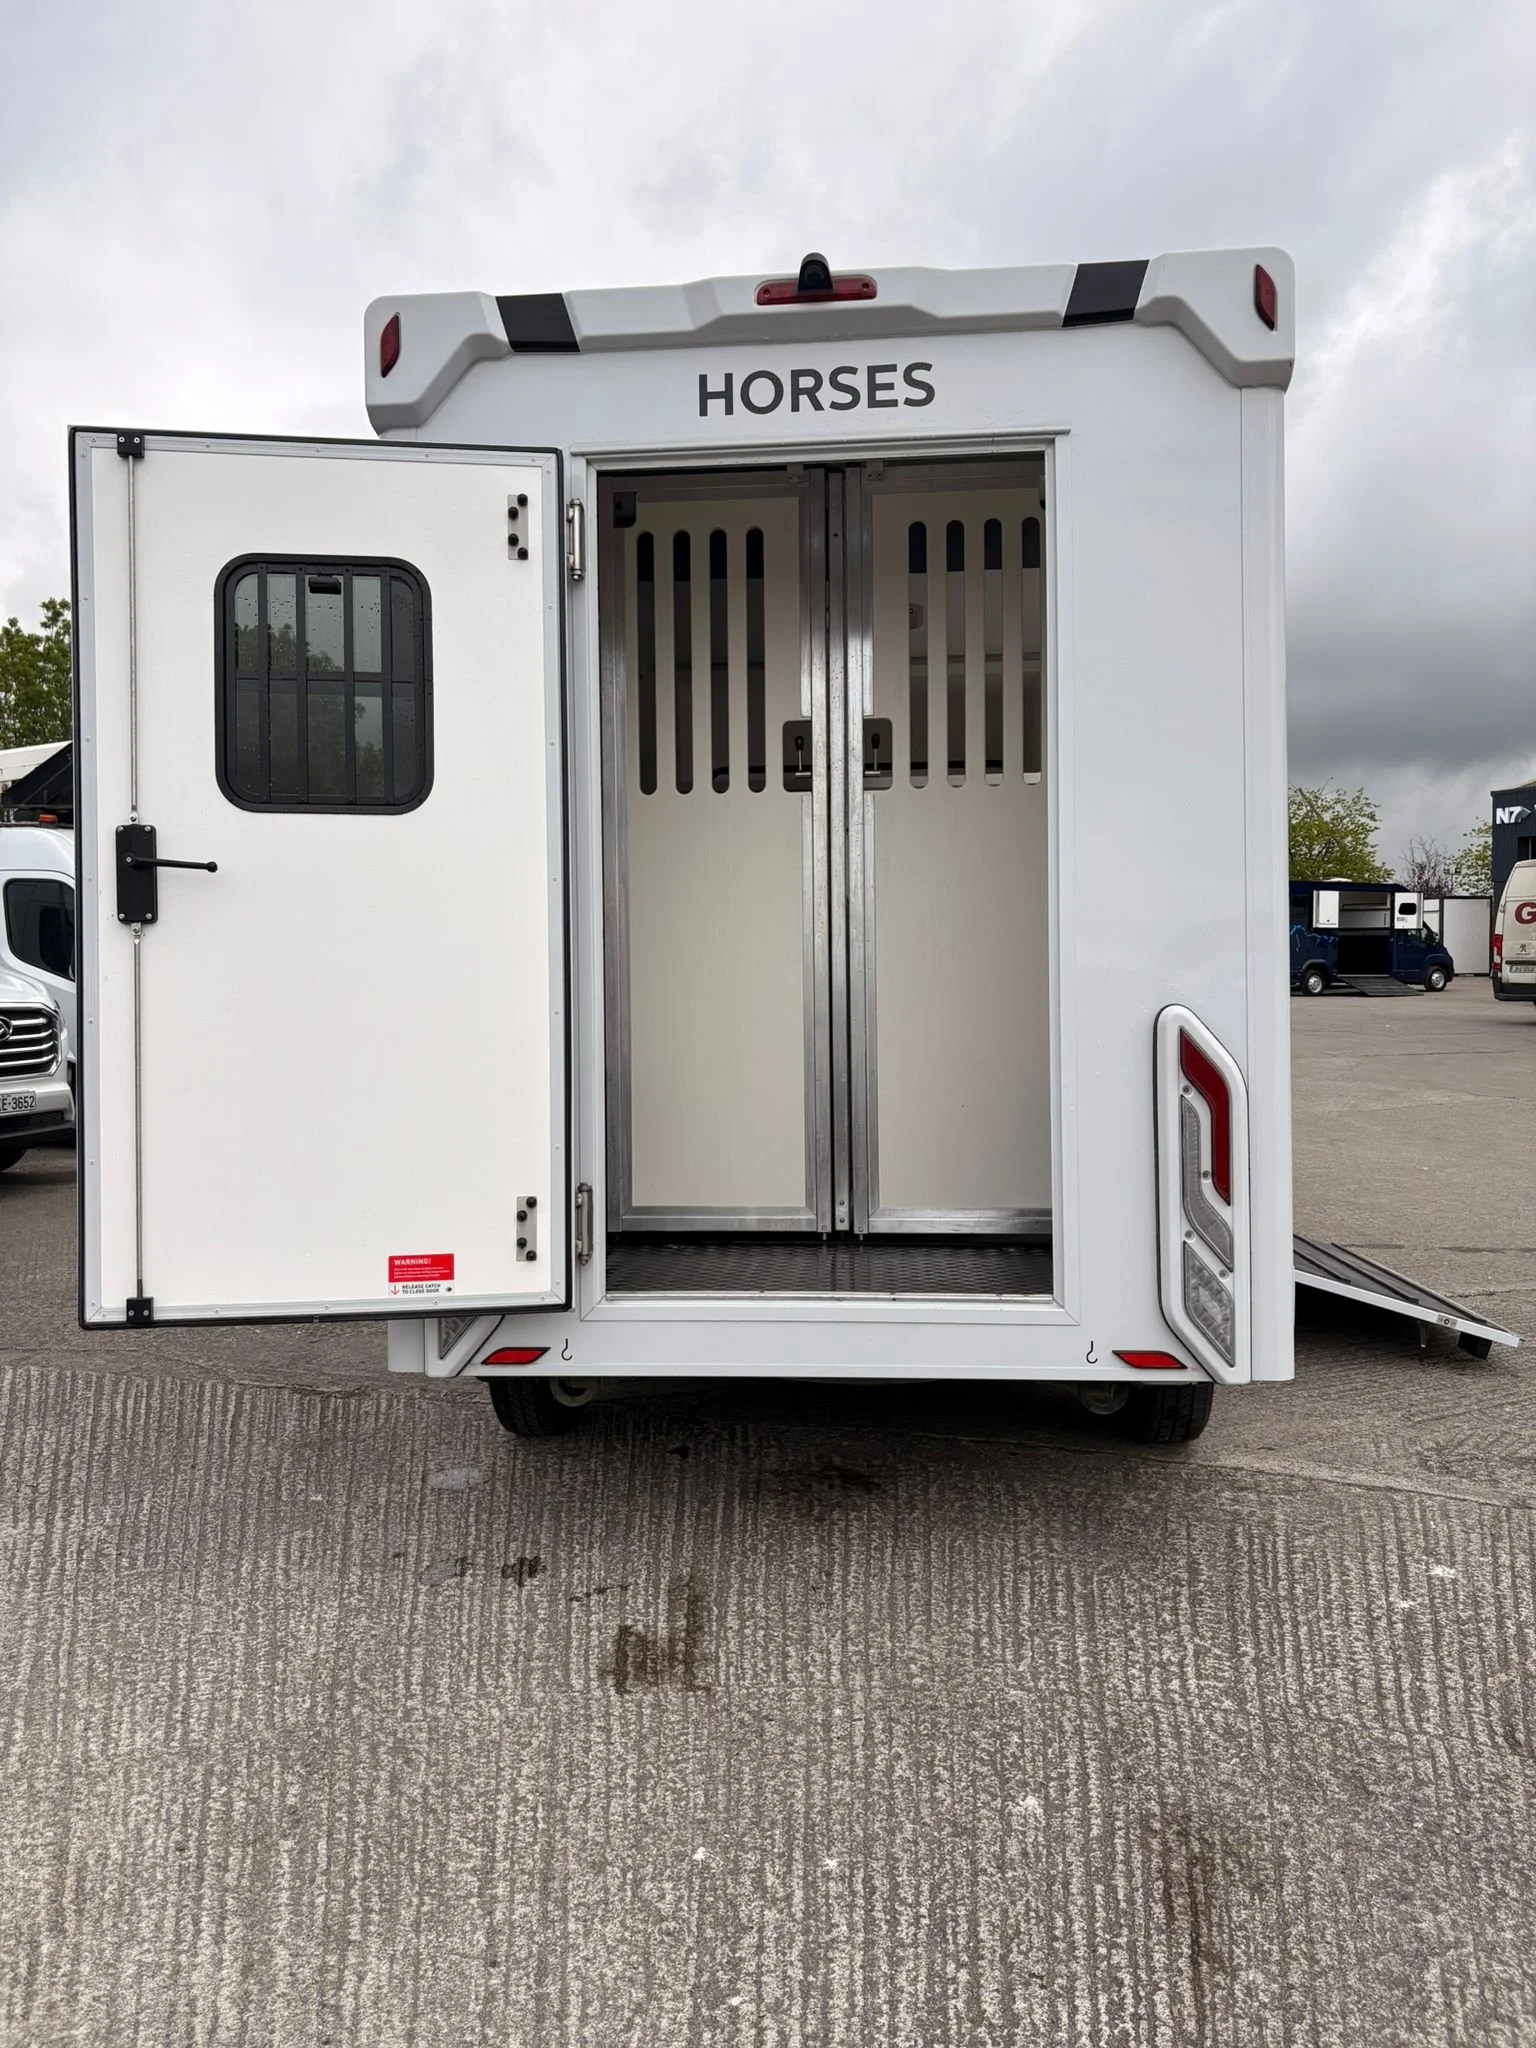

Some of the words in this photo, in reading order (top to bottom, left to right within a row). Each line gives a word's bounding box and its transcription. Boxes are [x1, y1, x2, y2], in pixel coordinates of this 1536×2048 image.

[699, 362, 935, 417] HORSES
[0, 1095, 35, 1111] E-3652
[394, 1257, 431, 1266] WARNING!
